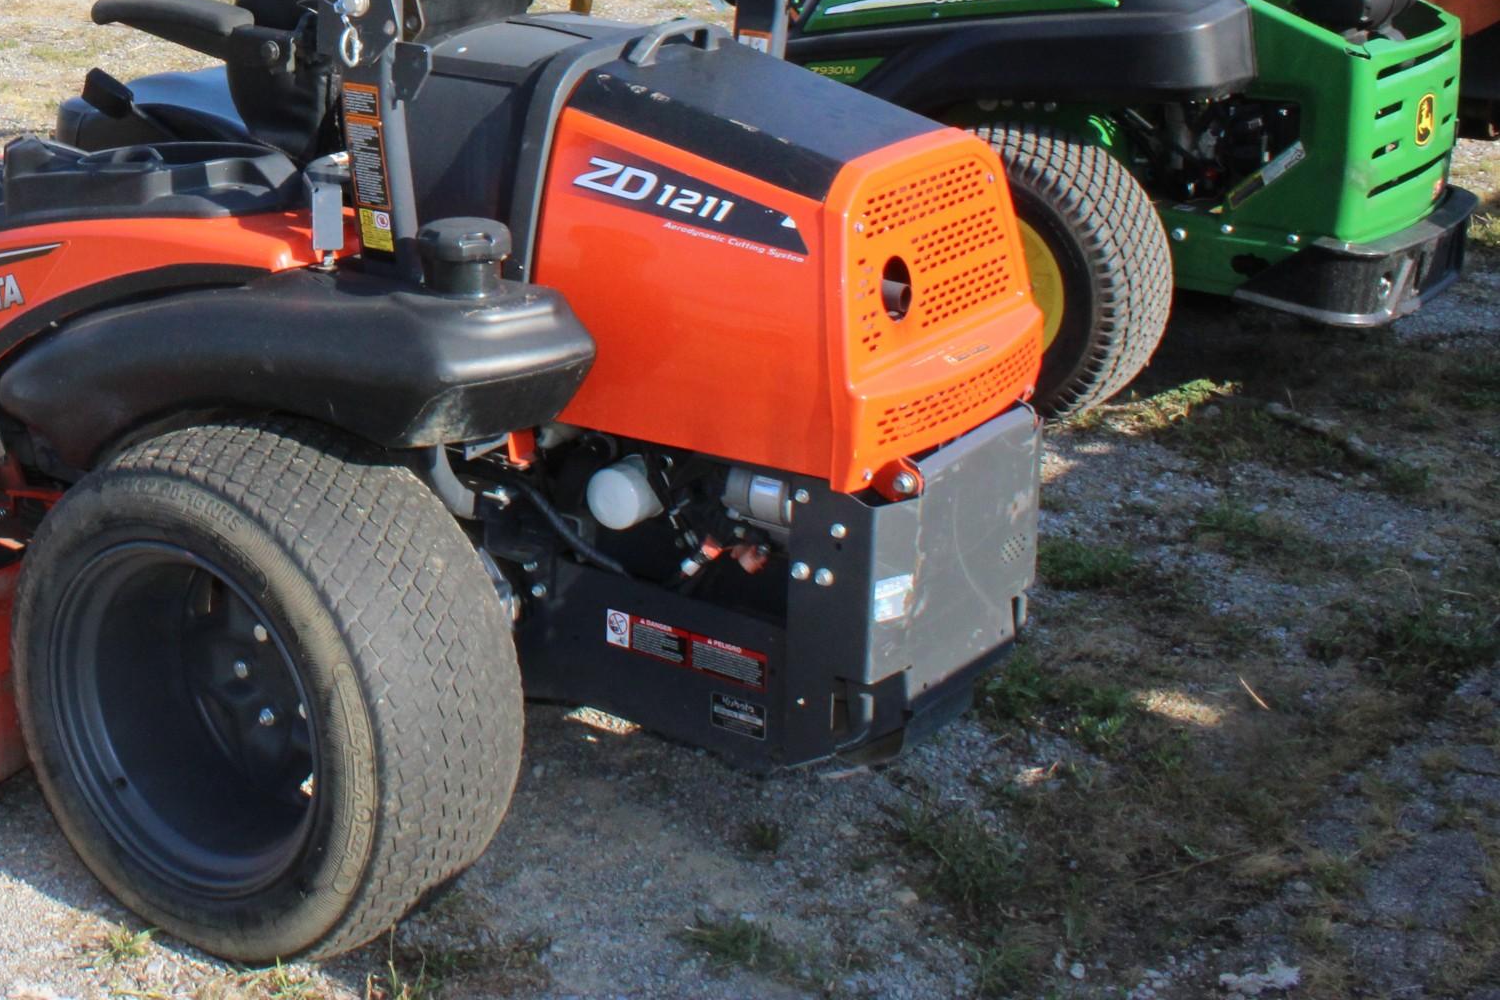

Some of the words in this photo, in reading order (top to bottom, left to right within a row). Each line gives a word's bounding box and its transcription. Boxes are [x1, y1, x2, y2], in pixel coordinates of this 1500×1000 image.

[572, 156, 659, 201] ZD
[656, 183, 735, 222] 1211
[662, 221, 725, 243] Aerodynamic
[727, 237, 766, 254] Cutting
[768, 247, 805, 263] System
